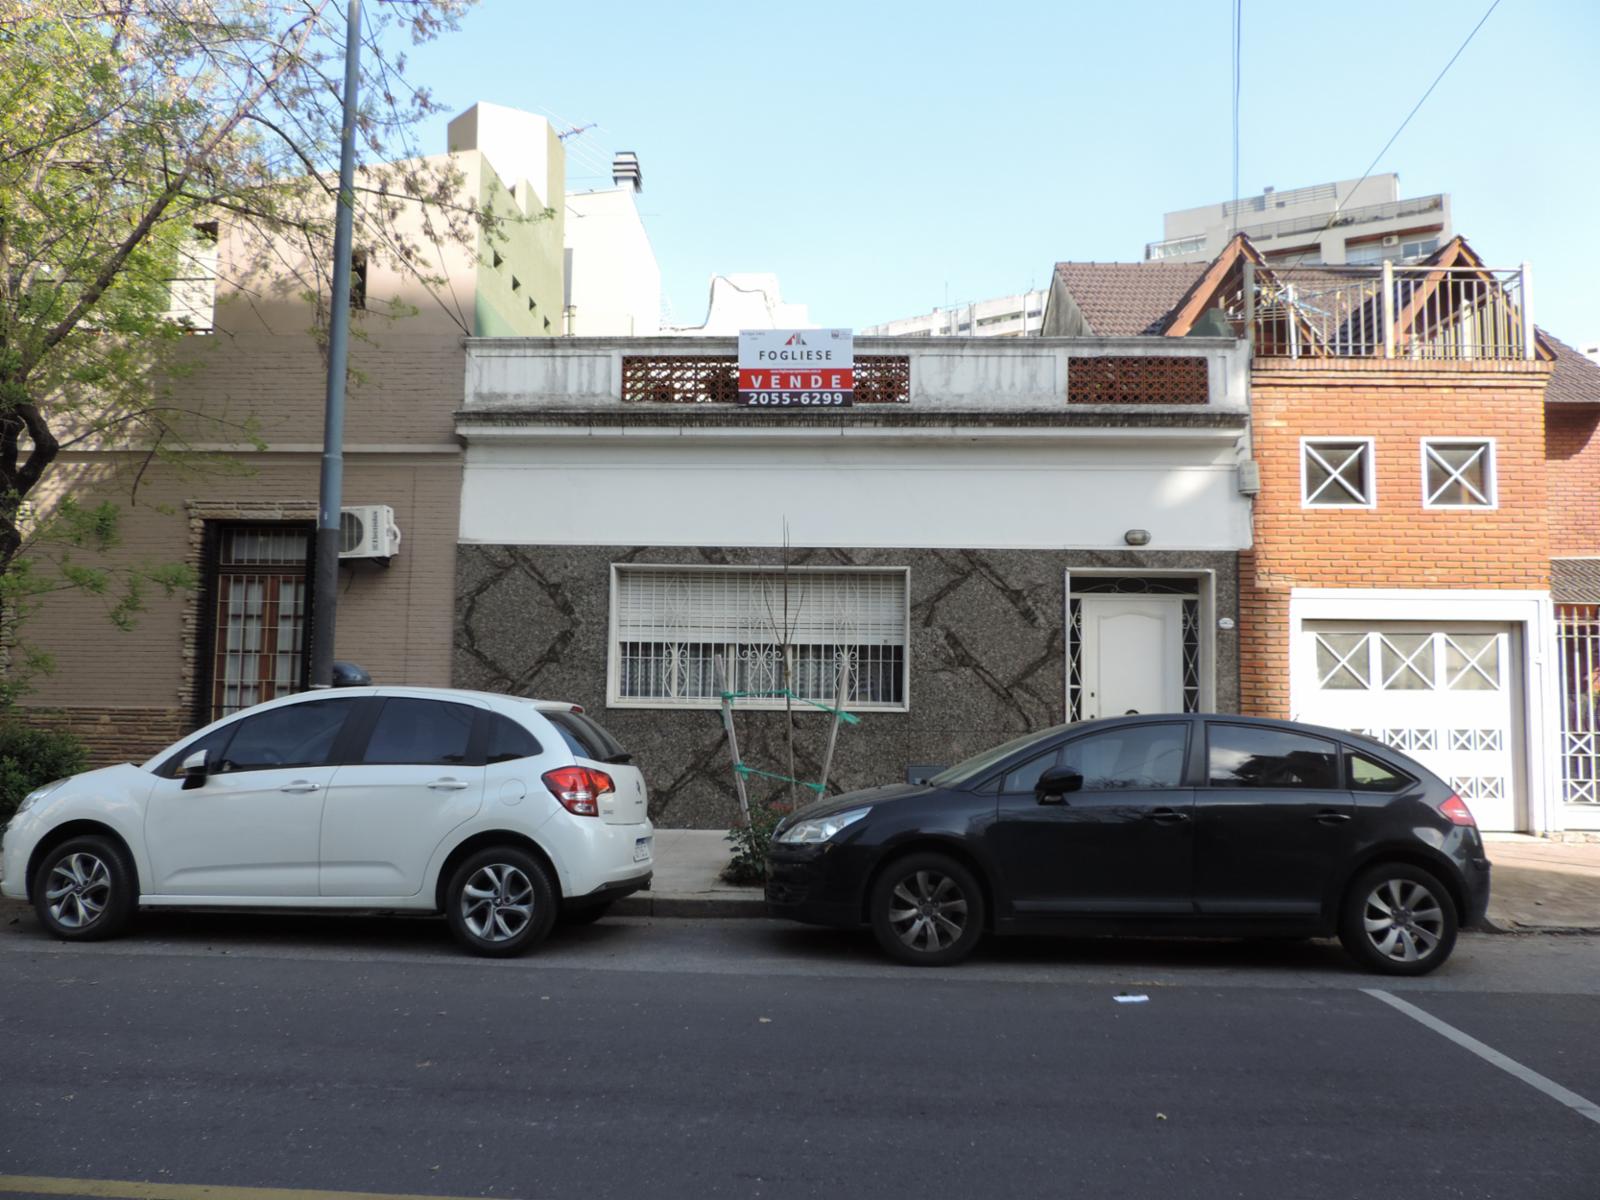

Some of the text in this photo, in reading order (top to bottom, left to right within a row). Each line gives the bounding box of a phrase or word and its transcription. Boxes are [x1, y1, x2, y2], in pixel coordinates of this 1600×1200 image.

[759, 350, 832, 360] FOGLIESE
[751, 375, 841, 388] VENDE
[748, 393, 843, 405] 2055-6299
